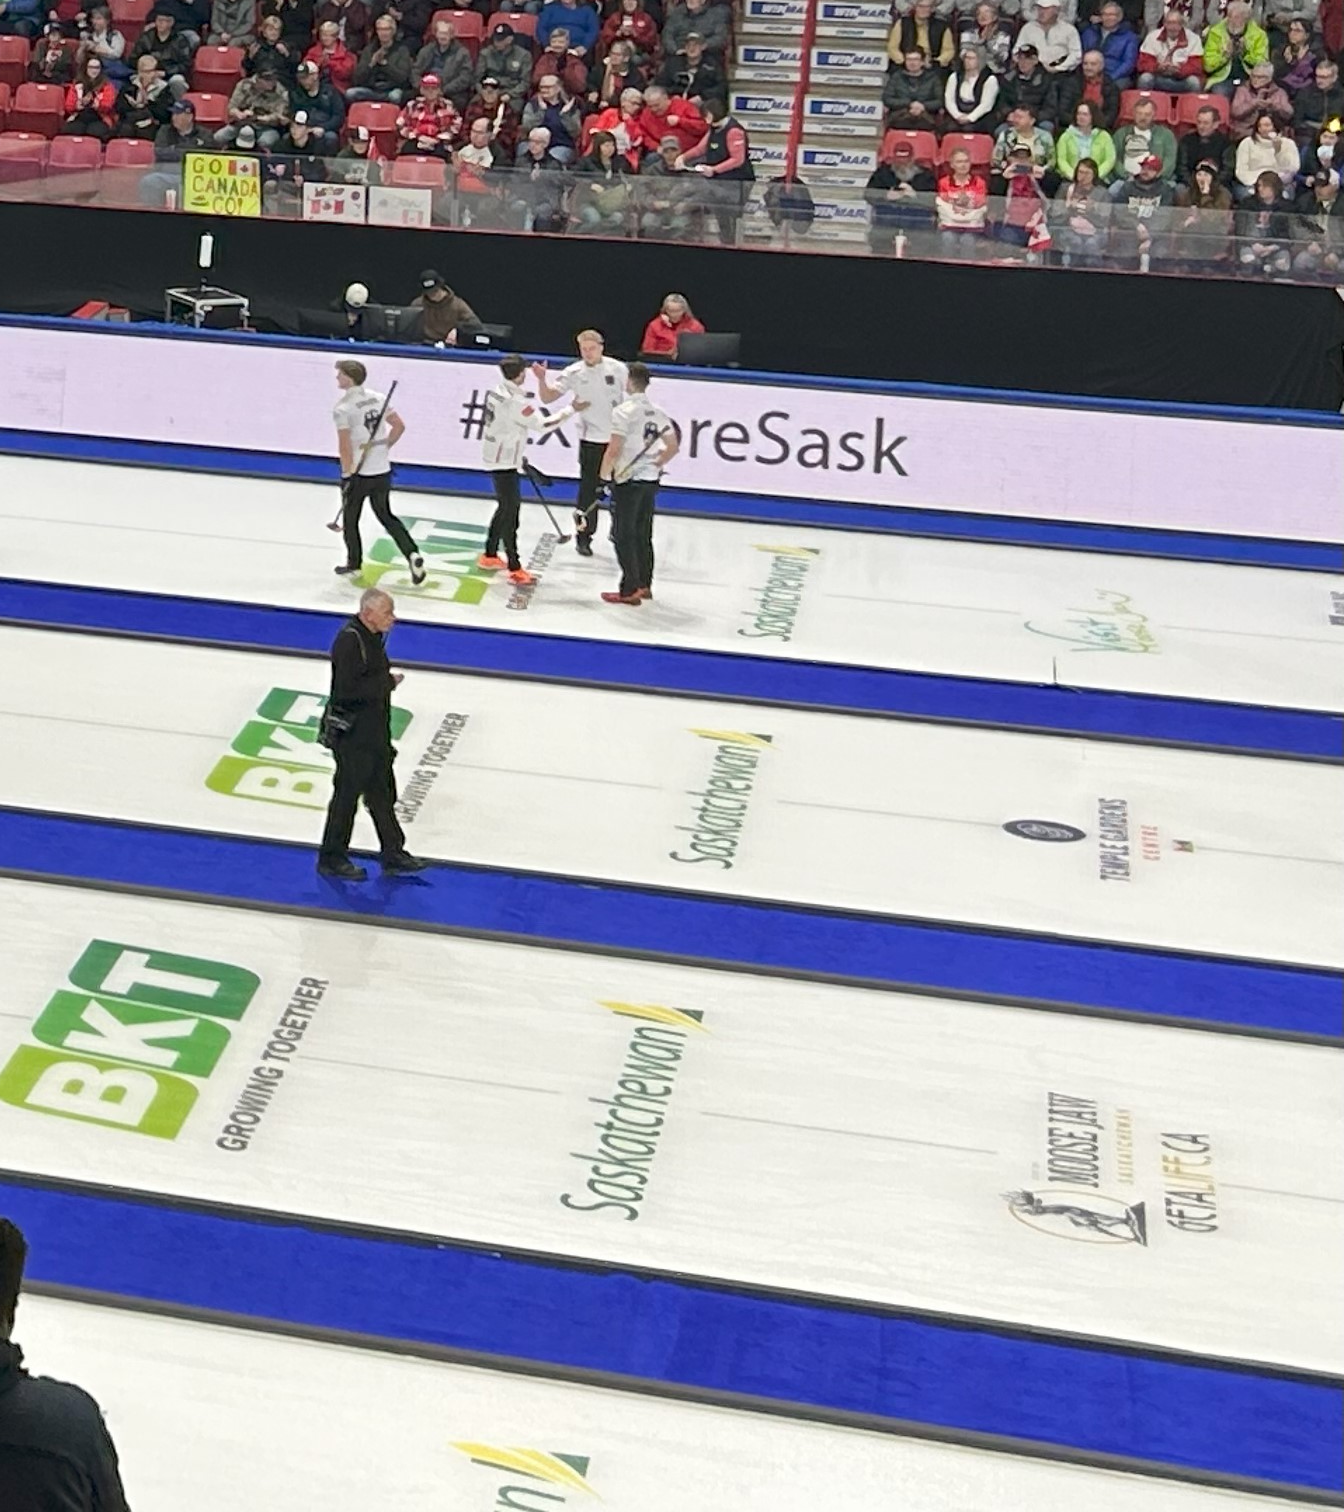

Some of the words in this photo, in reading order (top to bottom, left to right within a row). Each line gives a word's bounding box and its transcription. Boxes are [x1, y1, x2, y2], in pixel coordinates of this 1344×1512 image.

[834, 5, 889, 18] WINMAR
[829, 52, 882, 65] WINMAR
[822, 101, 877, 115] WINMAR
[192, 157, 222, 174] GO
[815, 151, 871, 166] WINMAR
[192, 175, 258, 195] CANADA
[737, 552, 811, 643] Saskatchewan
[422, 712, 471, 768] TOGETHER
[669, 743, 761, 870] Saskatchewan
[1098, 797, 1130, 842] GARDENS
[1099, 842, 1131, 883] TEMPLE
[1140, 825, 1162, 862] CENTRE
[17, 946, 227, 1130] BKT
[215, 1052, 284, 1153] GROWING
[262, 976, 330, 1065] TOGETHER
[560, 1026, 688, 1222] Saskatchewan
[1047, 1091, 1105, 1131] JAW
[1047, 1127, 1100, 1188] MOOSE
